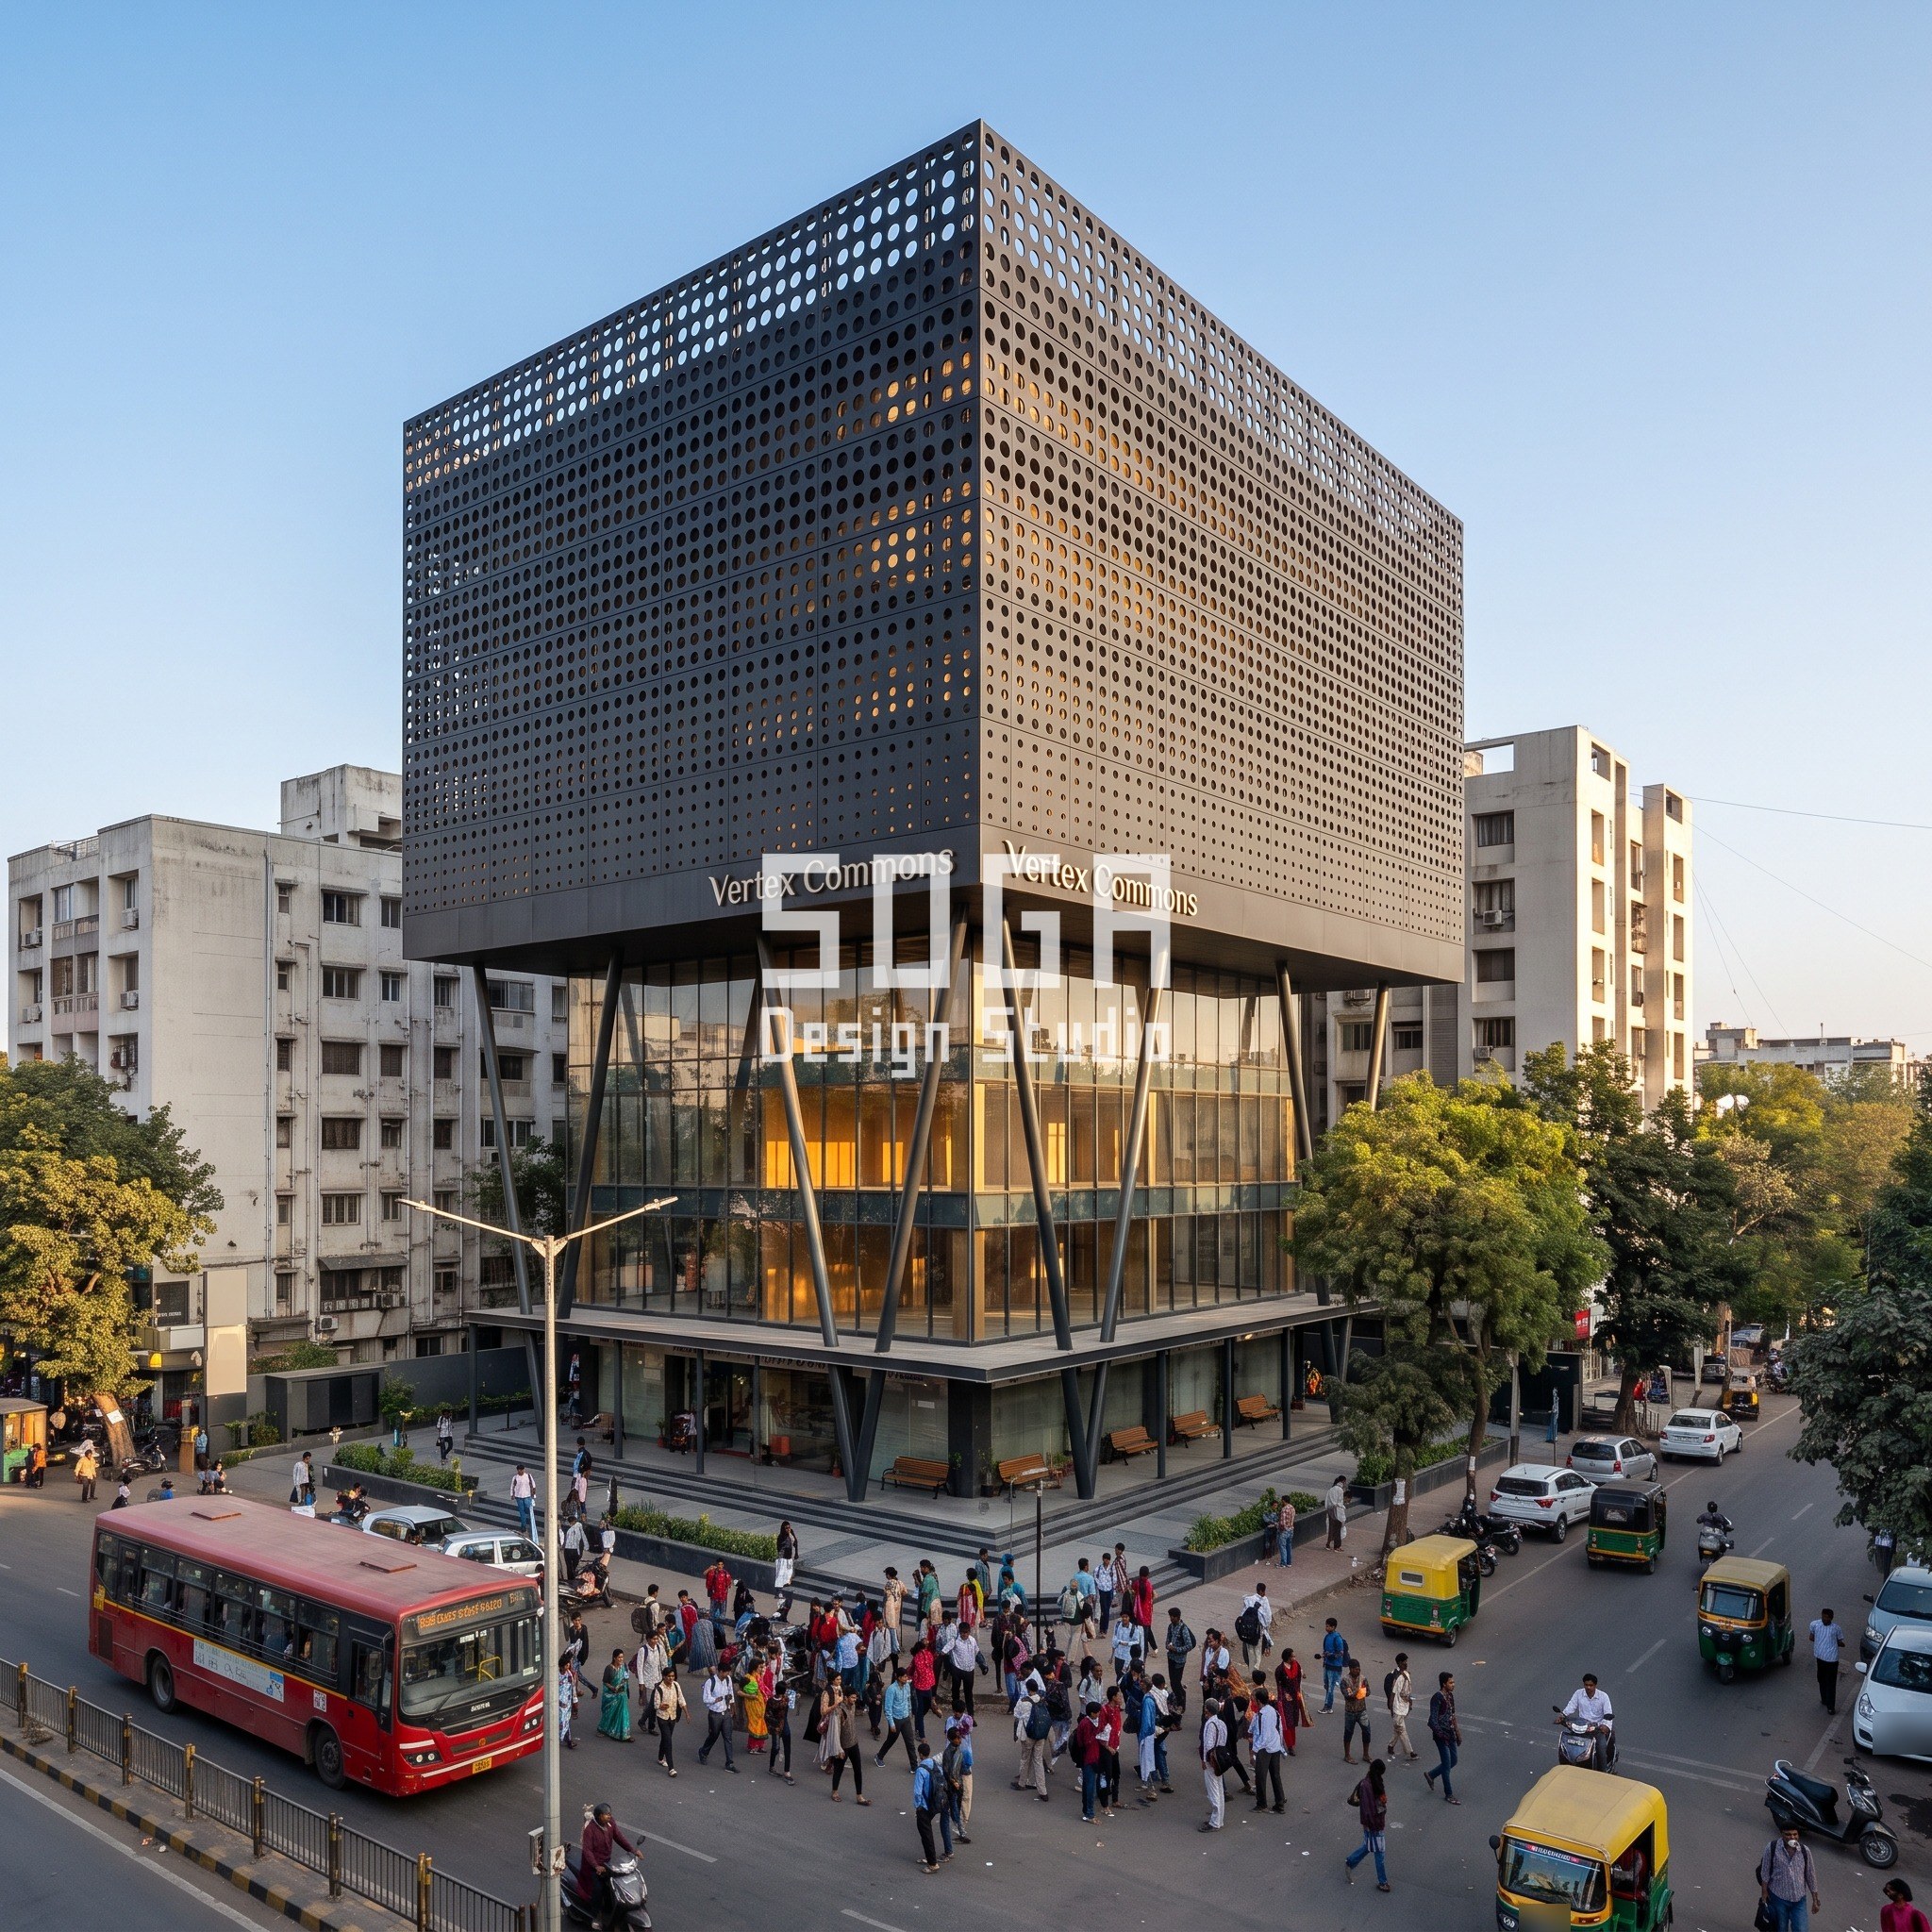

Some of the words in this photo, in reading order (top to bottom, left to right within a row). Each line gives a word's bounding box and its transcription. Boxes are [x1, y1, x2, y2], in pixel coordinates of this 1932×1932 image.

[708, 870, 796, 907] Vertex
[804, 848, 955, 894] Commons
[1002, 840, 1089, 892] Vertex
[1092, 863, 1198, 916] Commons
